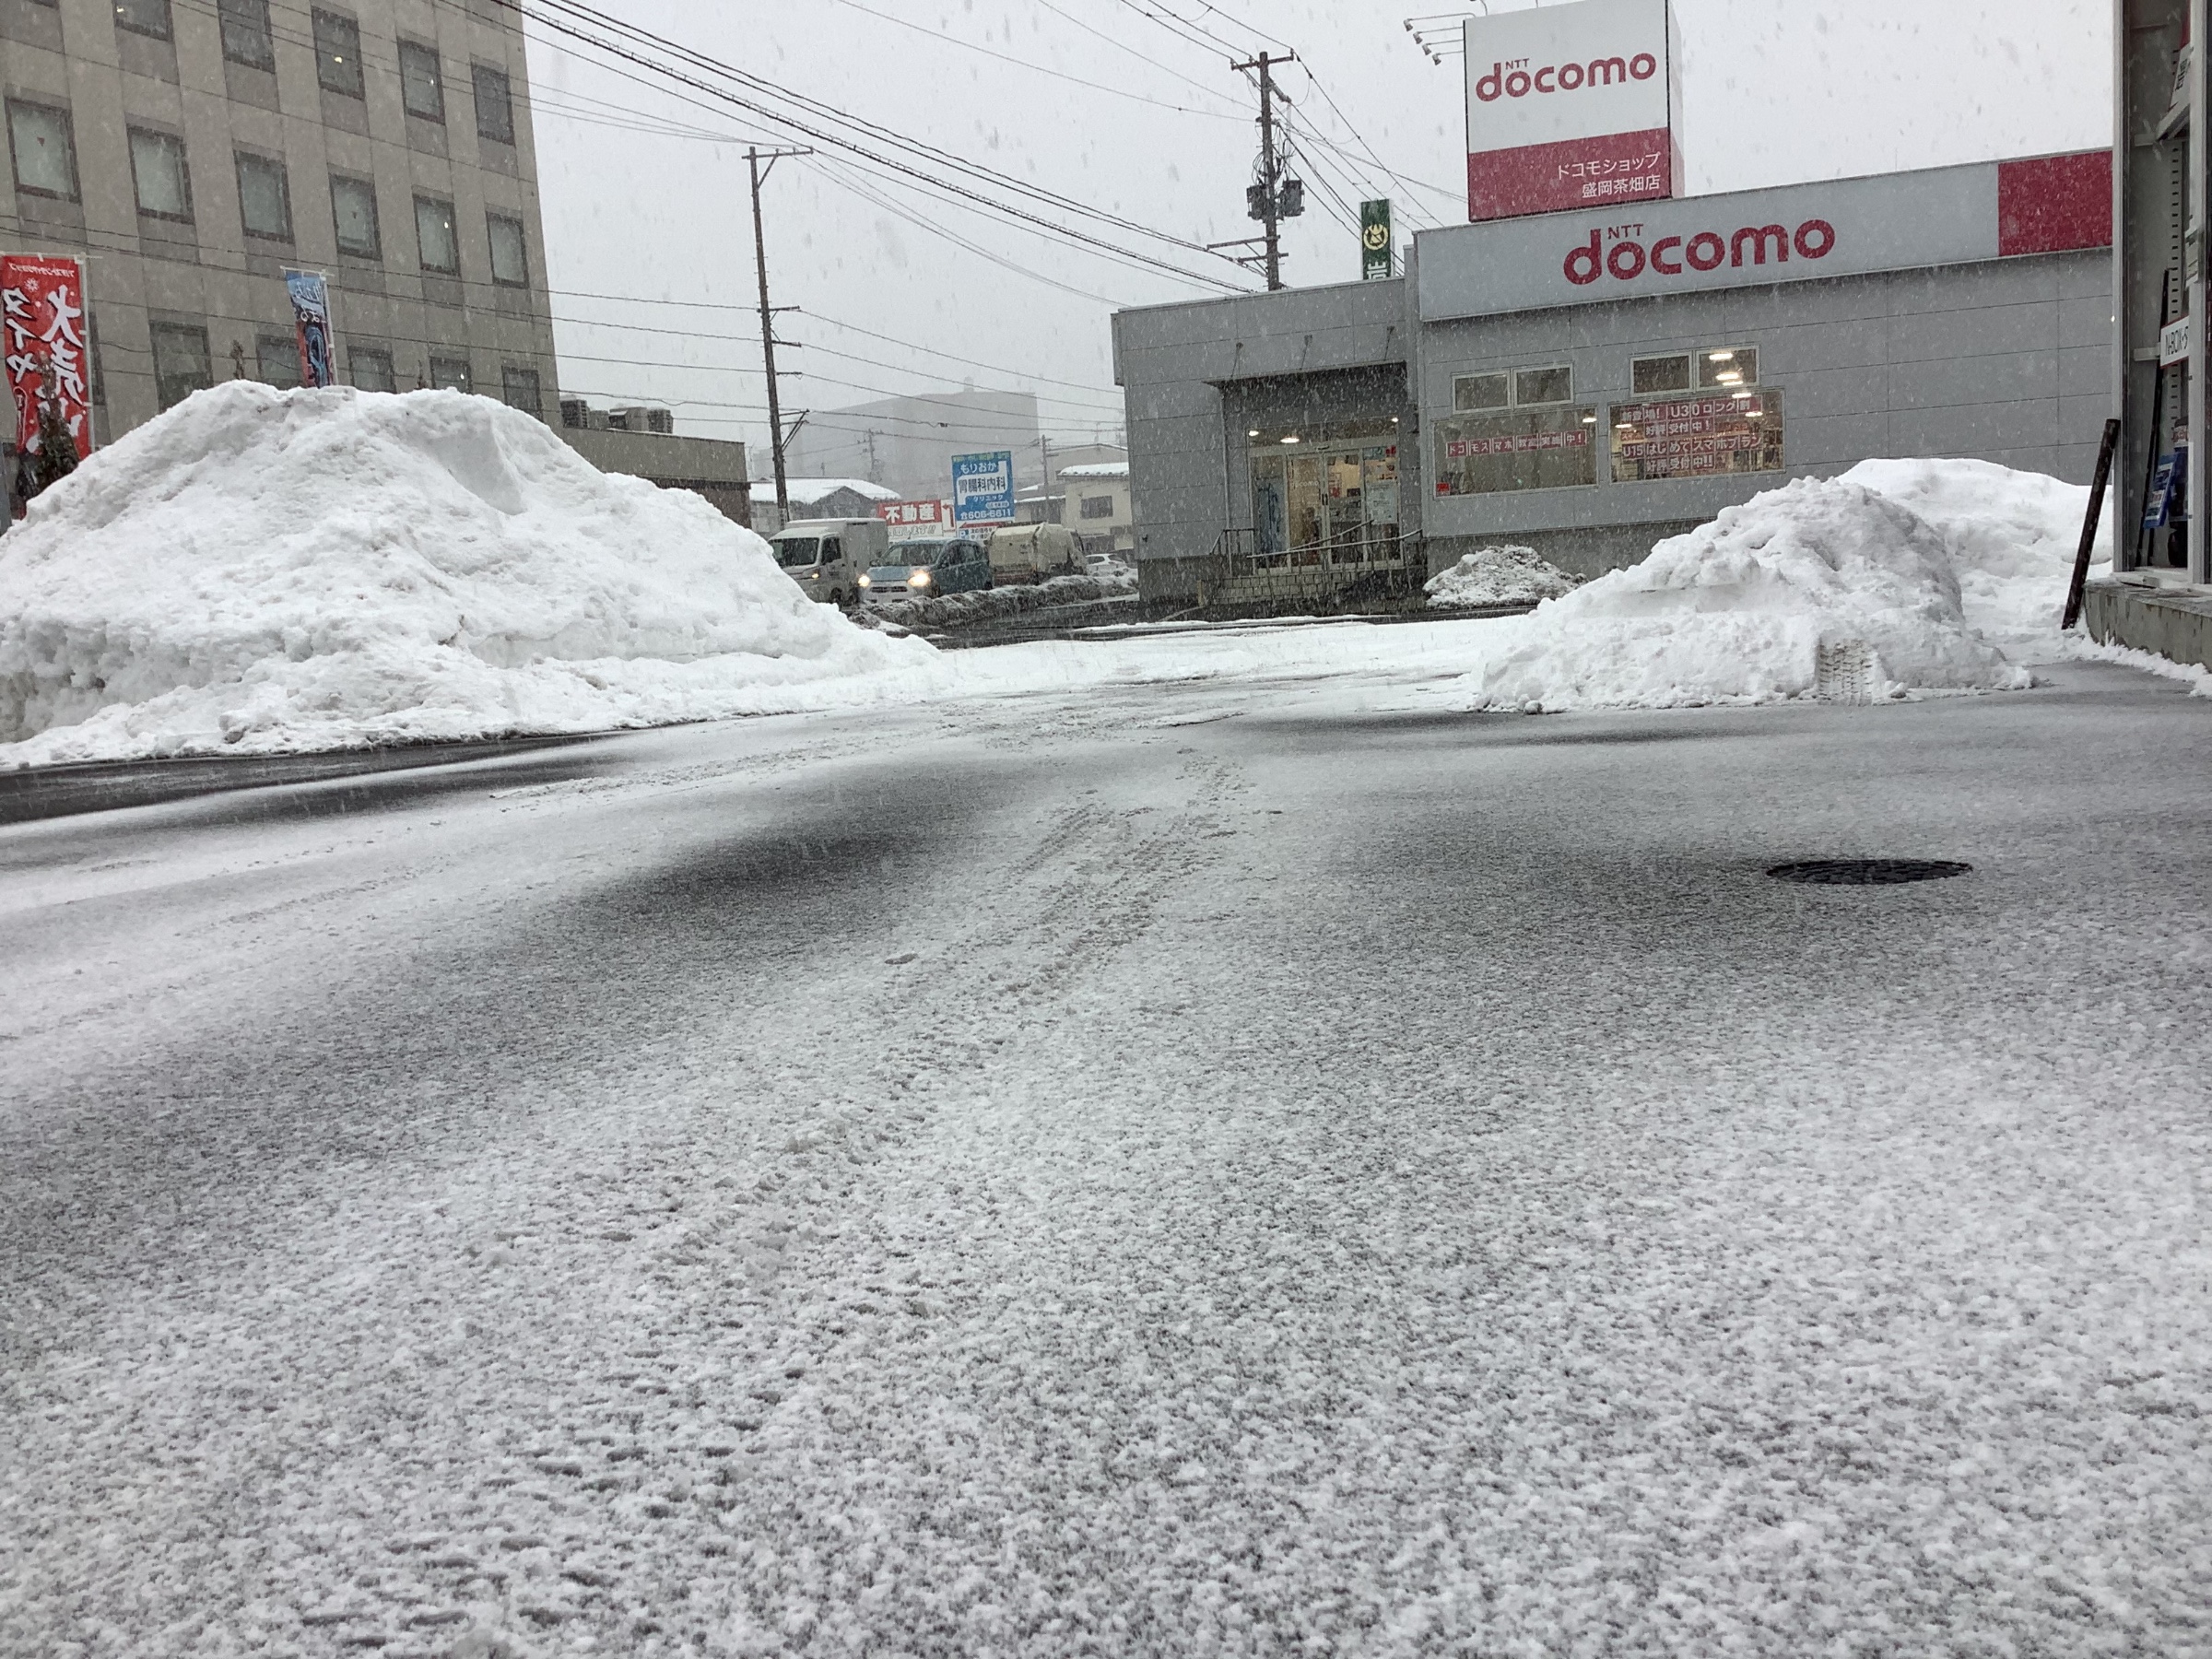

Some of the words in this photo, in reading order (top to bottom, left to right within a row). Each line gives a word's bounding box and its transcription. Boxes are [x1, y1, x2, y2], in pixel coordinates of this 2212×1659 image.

[1505, 58, 1529, 70] NTT
[1476, 53, 1656, 101] docomo
[1558, 152, 1661, 180] ドコモショップ
[1582, 174, 1661, 198] 盛岡茶畑店
[1607, 224, 1643, 240] NTT
[1563, 219, 1835, 285] docomo
[960, 462, 996, 474] もりおか
[959, 477, 1006, 493] 胃腸科内科
[885, 503, 935, 524] 不動産
